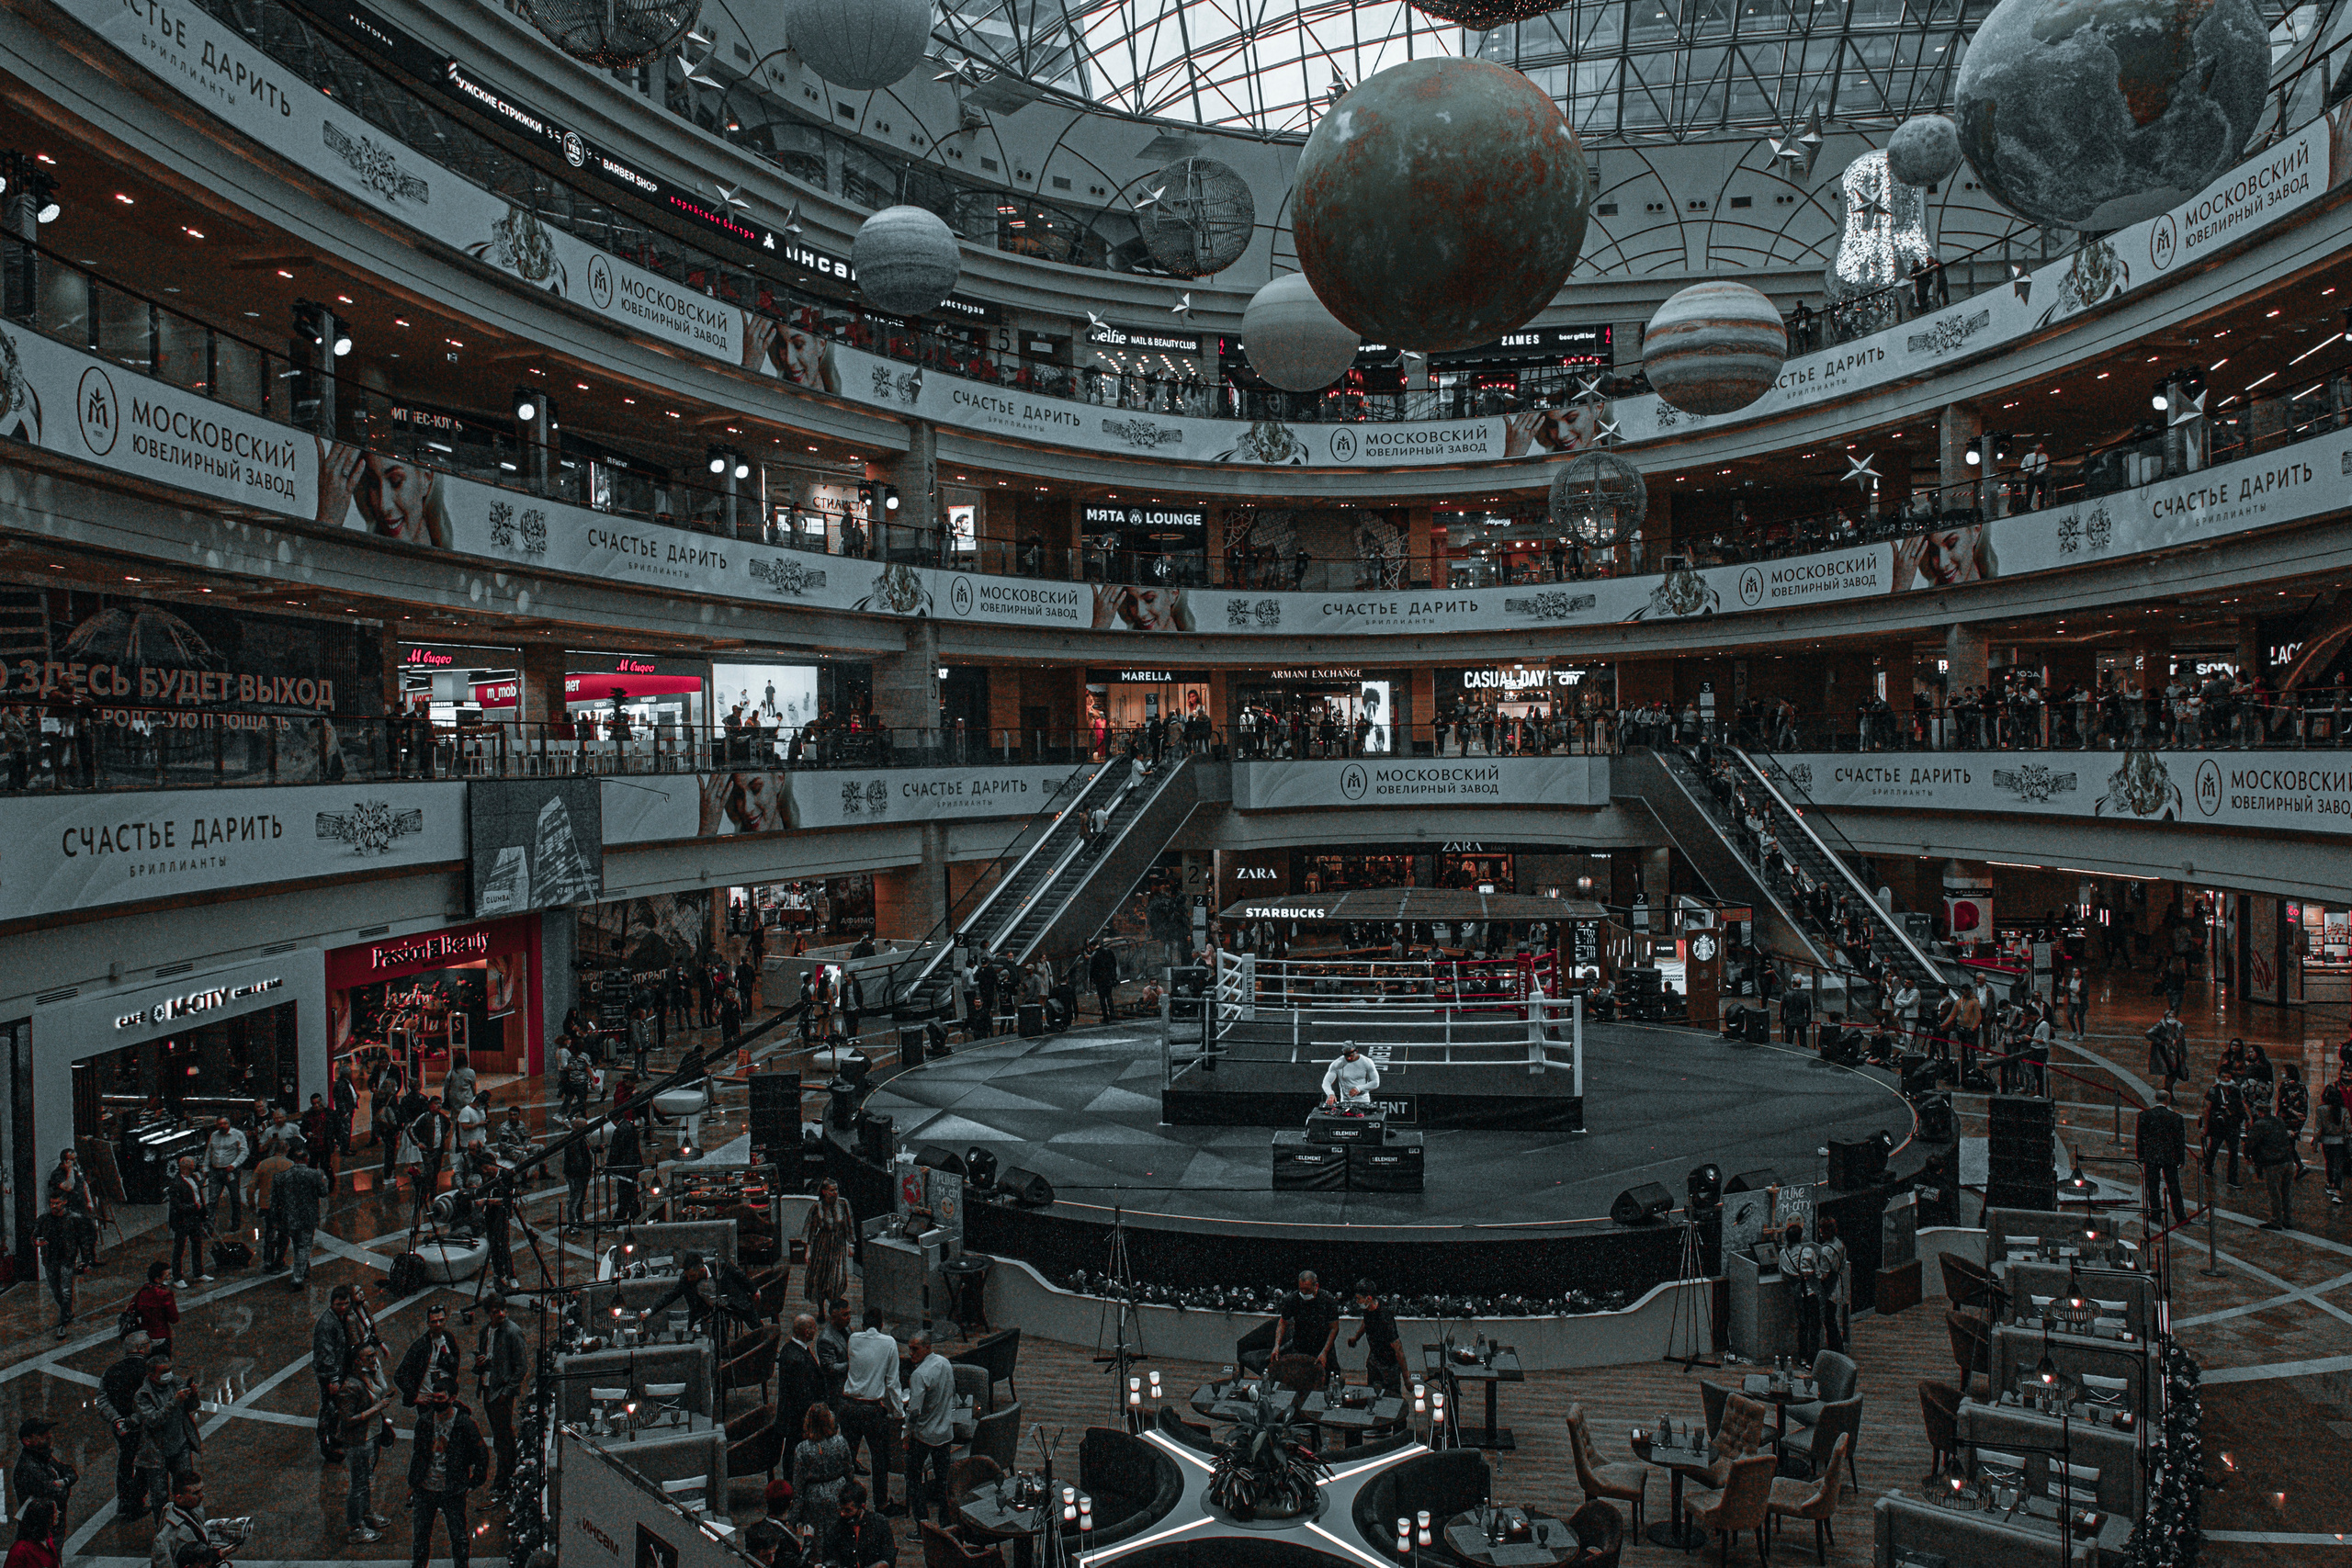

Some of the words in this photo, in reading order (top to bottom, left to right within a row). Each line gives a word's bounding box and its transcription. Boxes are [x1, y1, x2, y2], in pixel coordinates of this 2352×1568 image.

[349, 13, 393, 47] РЕСТОРАН
[123, 0, 186, 49] СТЬЕ
[201, 39, 290, 117] ДАРИТЬ
[141, 33, 235, 106] БРИЛЛИАНТЫ
[497, 99, 542, 133] СТРИЖКИ
[603, 157, 636, 184] BARBER
[635, 175, 658, 193] SHOP
[2185, 139, 2309, 230] МОСКОВСКИЙ
[670, 196, 720, 225] корейское
[723, 218, 755, 240] бистро
[2186, 195, 2263, 249] ЮВЕЛИРНЫЙ
[2267, 173, 2309, 207] ЗАВОД
[621, 275, 727, 333] МОСКОВСКИЙ
[940, 299, 985, 315] ресторан
[621, 298, 690, 335] ЮВЕЛИРНЫЙ
[694, 326, 727, 352] ЗАВОД
[999, 328, 1011, 351] 5
[1130, 335, 1148, 345] NAIL
[1154, 338, 1180, 348] BEAUTY
[1180, 340, 1197, 350] CLUB
[1501, 334, 1540, 346] ZAMES
[1770, 367, 1815, 392] АСТЬЕ
[1825, 346, 1884, 379] ДАРИТЬ
[1787, 378, 1848, 400] БРИЛЛИАНТЫ
[953, 390, 1014, 415] СЧАСТЬЕ
[1023, 405, 1080, 427] ДАРИТЬ
[391, 407, 463, 432] ИТЕС-КЛБ
[988, 416, 1045, 433] БРИЛЛИАНТЫ
[132, 396, 295, 471] МОСКОВСКИЙ
[1366, 424, 1487, 446] МОСКОВСКИЙ
[1366, 444, 1443, 457] ЮВЕЛИРНЫЙ
[1448, 443, 1487, 454] ЗАВОД
[132, 434, 242, 482] ЮВЕЛИРНЫЙ
[245, 468, 296, 502] ЗАВОД
[2153, 483, 2228, 519] СЧАСТЬЕ
[2239, 462, 2312, 502] ДАРИТЬ
[1087, 508, 1125, 522] МЯТА
[1146, 513, 1202, 526] LOUNGE
[2196, 502, 2267, 527] БРИЛЛИАНТЫ
[588, 529, 657, 558] СЧАСТЬЕ
[667, 544, 727, 570] ДАРИТЬ
[628, 561, 690, 580] БРИЛЛИАНТЫ
[1770, 552, 1877, 584] МОСКОВСКИЙ
[980, 585, 1078, 605] МОСКОВСКИЙ
[1770, 578, 1840, 598] ЮВЕЛИРНЫЙ
[1843, 573, 1877, 590] ЗАВОД
[980, 602, 1042, 616] ЮВЕЛИРНЫЙ
[1046, 608, 1078, 621] ЗАВОД
[1322, 603, 1398, 615] СЧАСТЬЕ
[1408, 600, 1478, 615] ДАРИТЬ
[1122, 671, 1171, 682] MARELLA
[1271, 670, 1307, 679] ARMANI
[1312, 669, 1363, 679] EXCHANGE
[1464, 671, 1514, 689] CASUAL
[1521, 670, 1545, 687] DAY
[1558, 674, 1580, 685] CITY
[19, 659, 131, 706] ЗДЕСЬ
[139, 666, 233, 706] БУДЕТ
[239, 673, 335, 713] ВЫХОД
[487, 682, 516, 702] m_mob
[1703, 682, 1711, 693] 3
[1376, 765, 1499, 782] МОСКОВСКИЙ
[1835, 768, 1901, 784] СЧАСТЬЕ
[1910, 768, 1972, 784] ДАРИТЬ
[2232, 769, 2352, 794] МОСКОВСКИ
[903, 782, 963, 797] СЧАСТЬЕ
[971, 780, 1028, 795] ДАРИТЬ
[1376, 783, 1456, 795] ЮВЕЛИРНЫЙ
[1460, 784, 1499, 795] ЗАВОД
[1871, 788, 1934, 797] БРИЛЛИАНТЫ
[936, 799, 993, 809] БРИЛЛИАНТЫ
[2232, 791, 2313, 814] ЮВЕЛИРНЫЙ
[2317, 799, 2352, 818] ЗАВО
[62, 820, 175, 858] СЧАСТЬЕ
[191, 814, 283, 850] ДАРИТЬ
[1442, 840, 1484, 852] ZARA
[130, 855, 228, 879] БРИЛЛИАНТЫ
[1188, 865, 1200, 885] 2
[1237, 867, 1278, 879] ZARA
[1197, 896, 1204, 907] 2
[1636, 893, 1645, 905] 2
[840, 916, 876, 925] АФИМО
[1246, 908, 1325, 919] STARBUCKS
[957, 934, 966, 947] 2
[2038, 928, 2047, 942] 2
[441, 931, 491, 960] Beauty
[1368, 1122, 1381, 1130] 30
